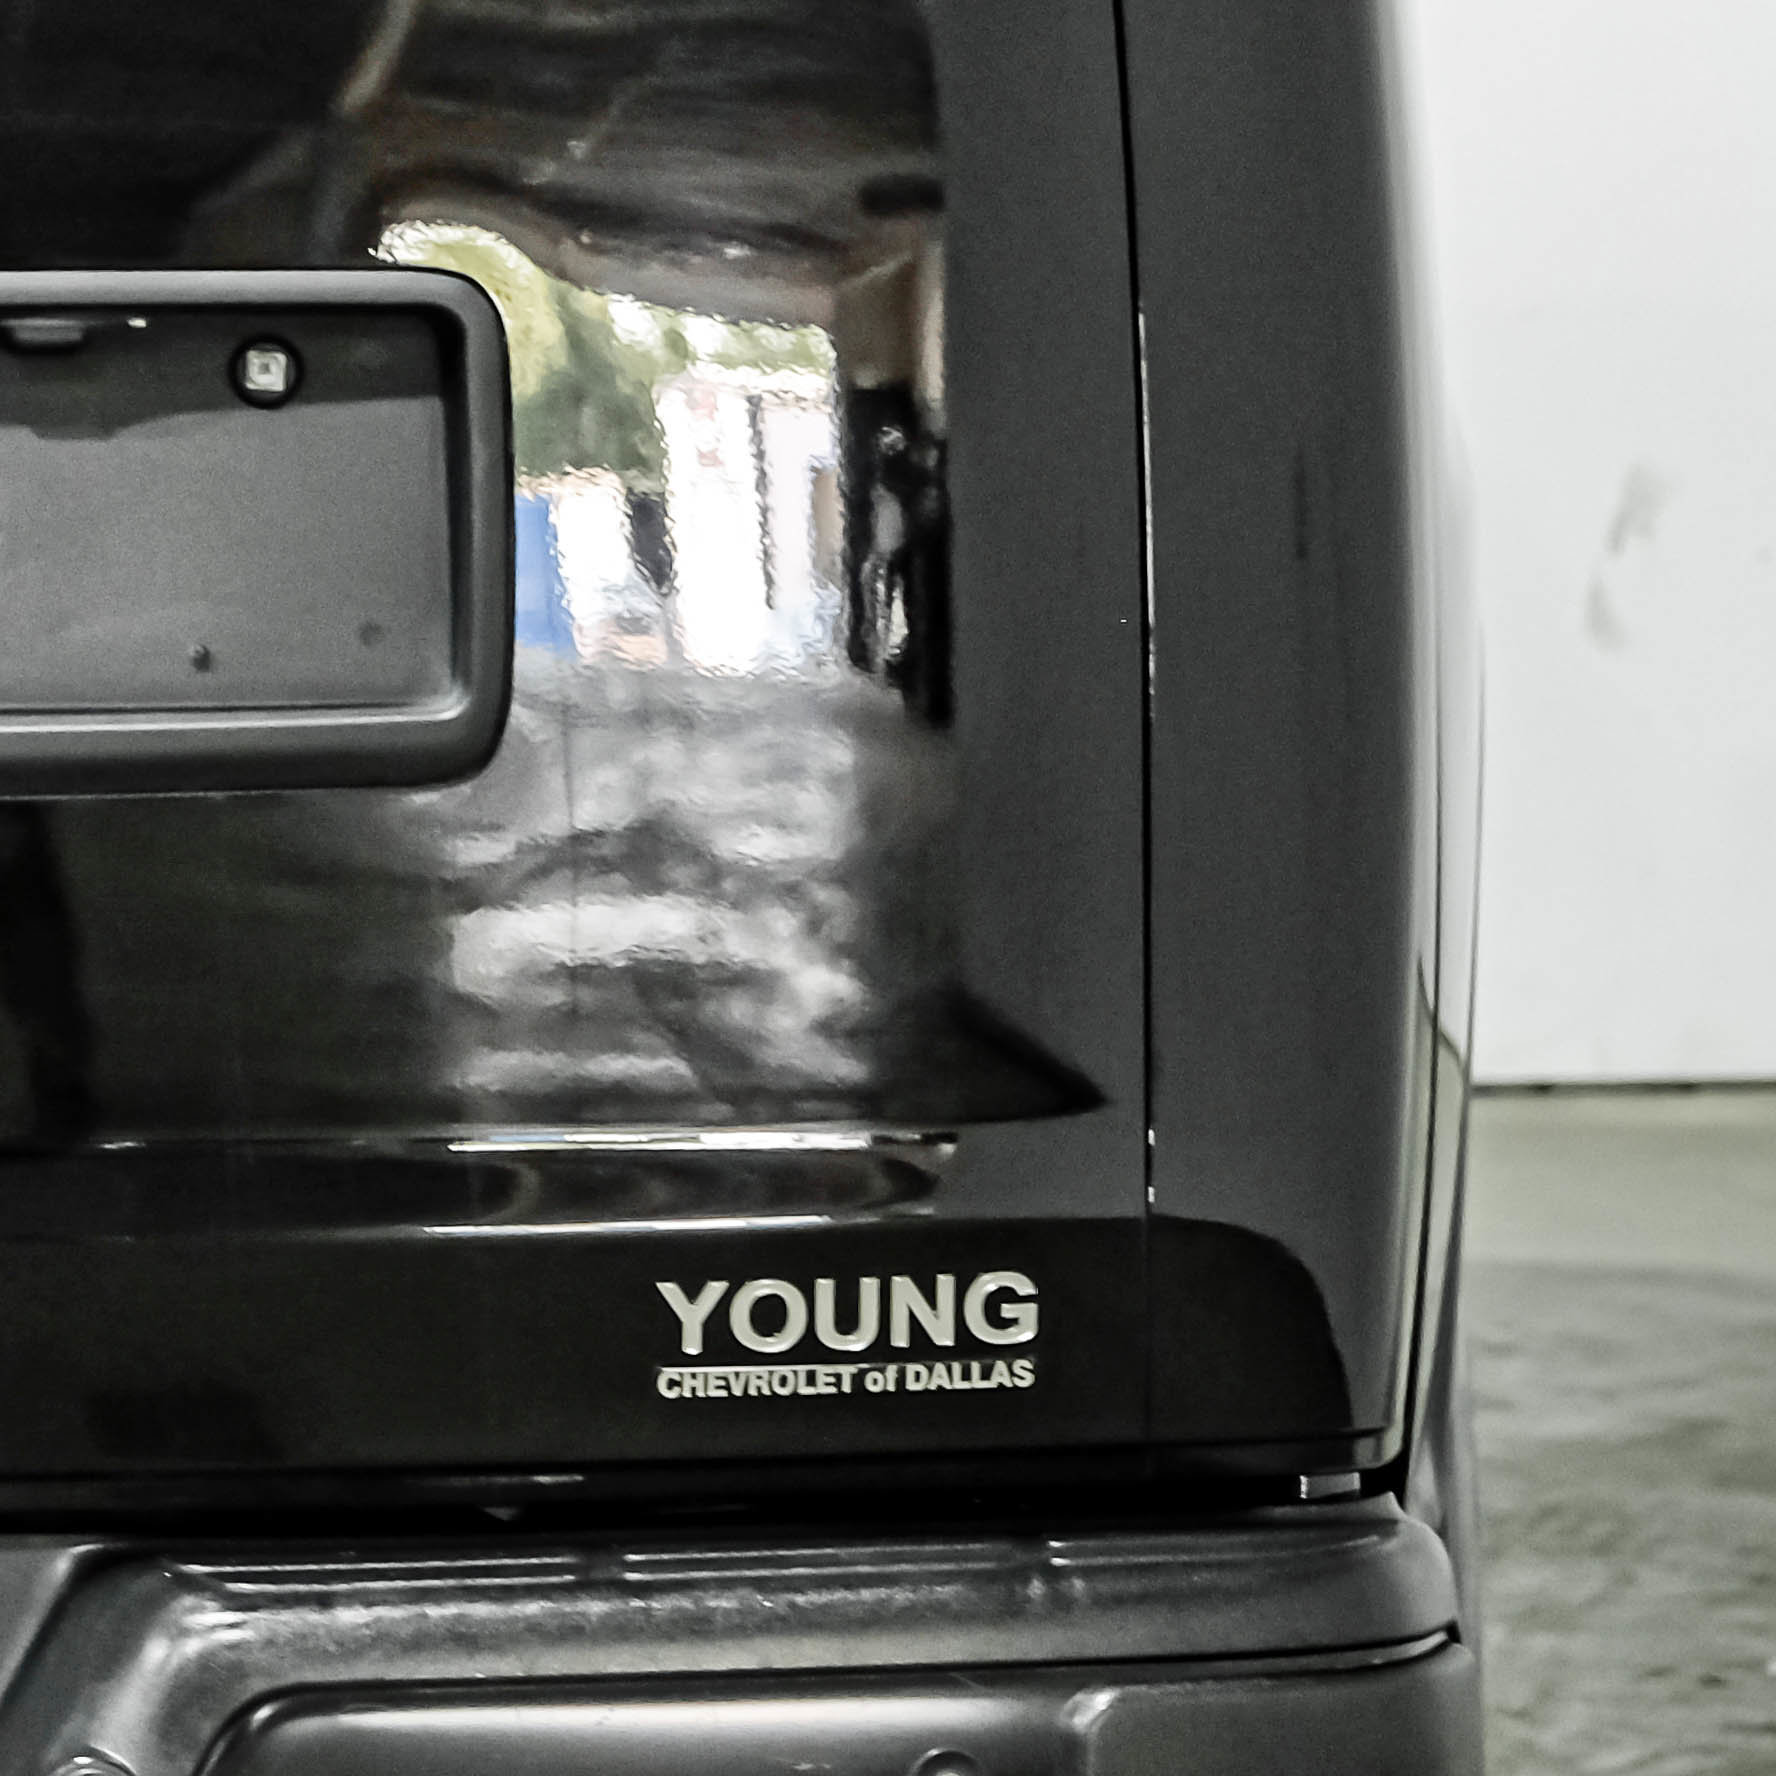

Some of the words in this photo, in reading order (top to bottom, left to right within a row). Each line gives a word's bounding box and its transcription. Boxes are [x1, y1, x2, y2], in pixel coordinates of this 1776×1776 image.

[655, 1271, 1039, 1355] YOUNG
[656, 1367, 858, 1399] CHEVROLET
[864, 1365, 898, 1393] of
[904, 1359, 1036, 1392] DALLAS
